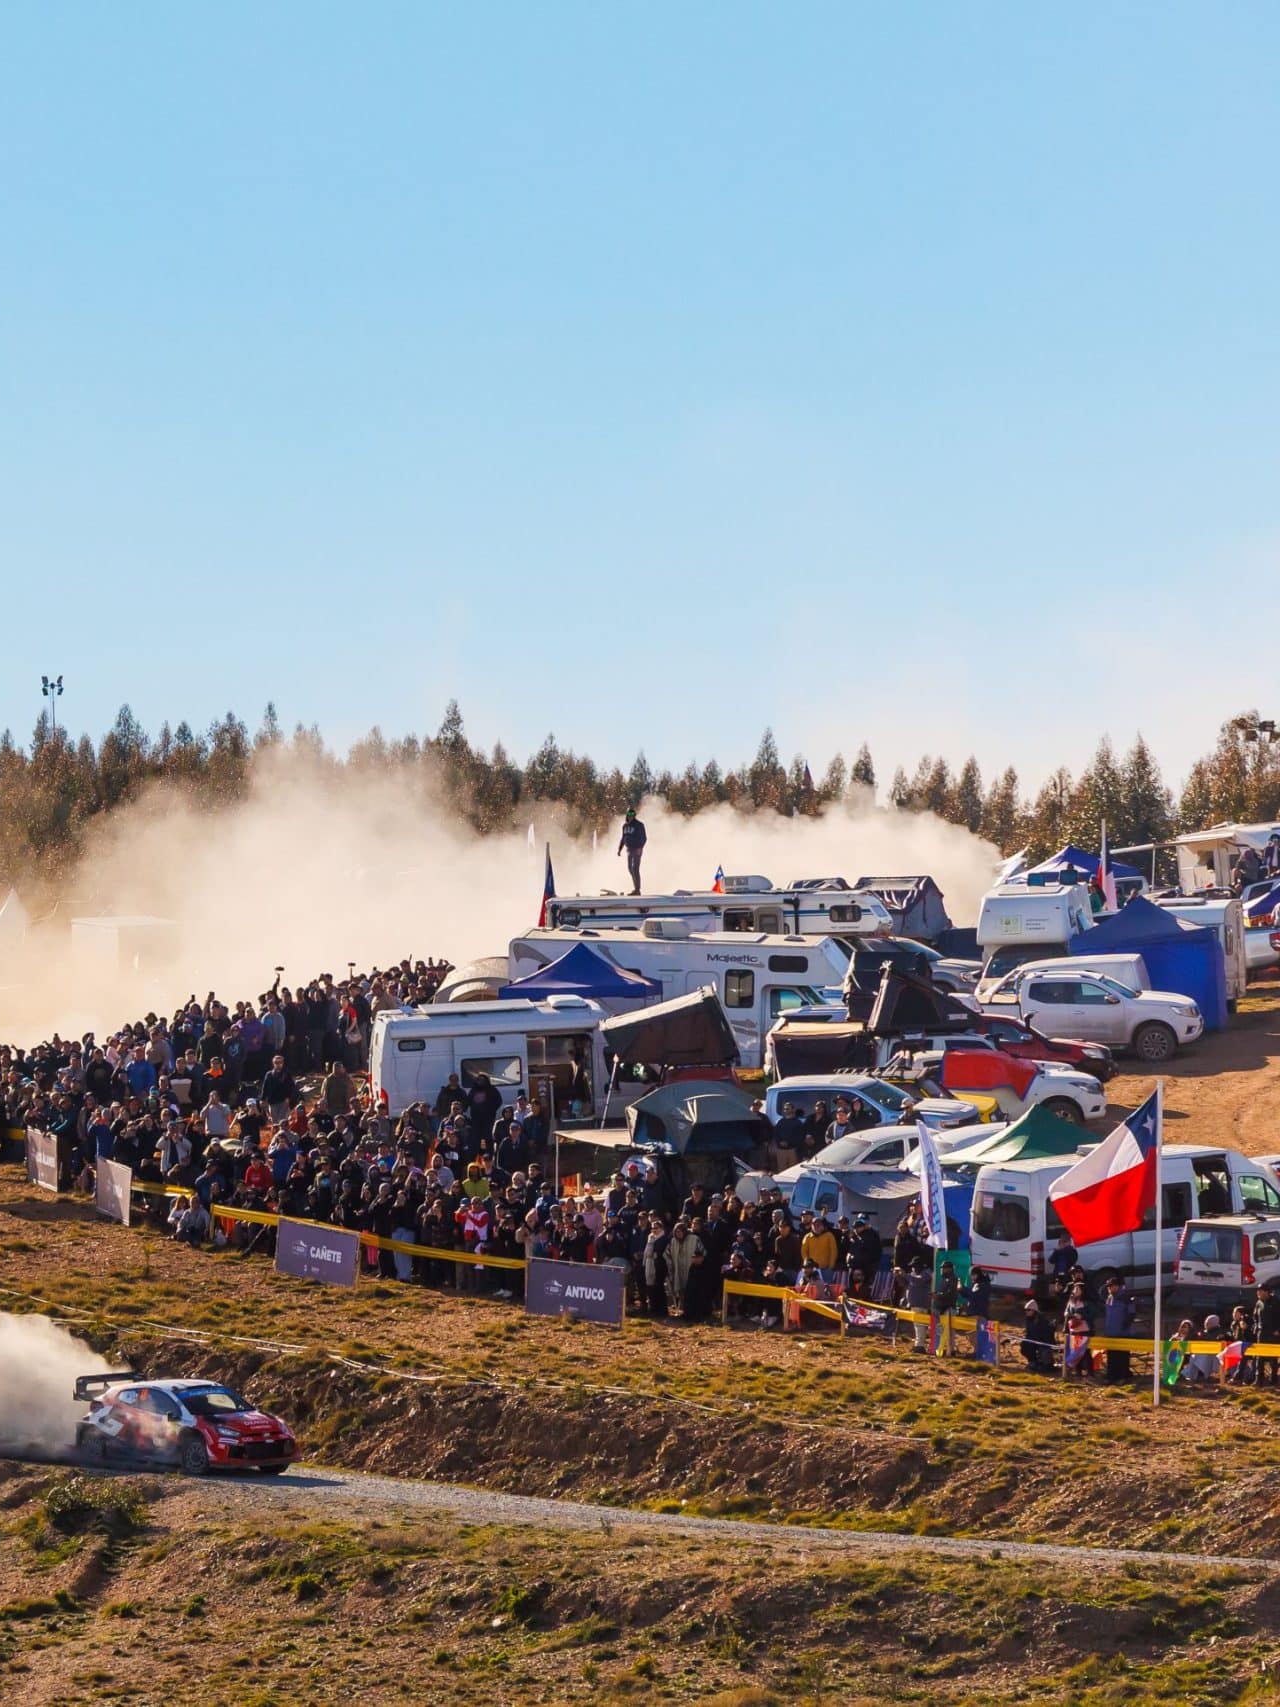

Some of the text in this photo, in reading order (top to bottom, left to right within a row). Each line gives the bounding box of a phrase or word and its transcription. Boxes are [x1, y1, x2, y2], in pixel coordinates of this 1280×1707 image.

[706, 953, 759, 963] Majestic
[310, 1245, 342, 1263] CAÑETE
[565, 1285, 605, 1301] ANTUCO
